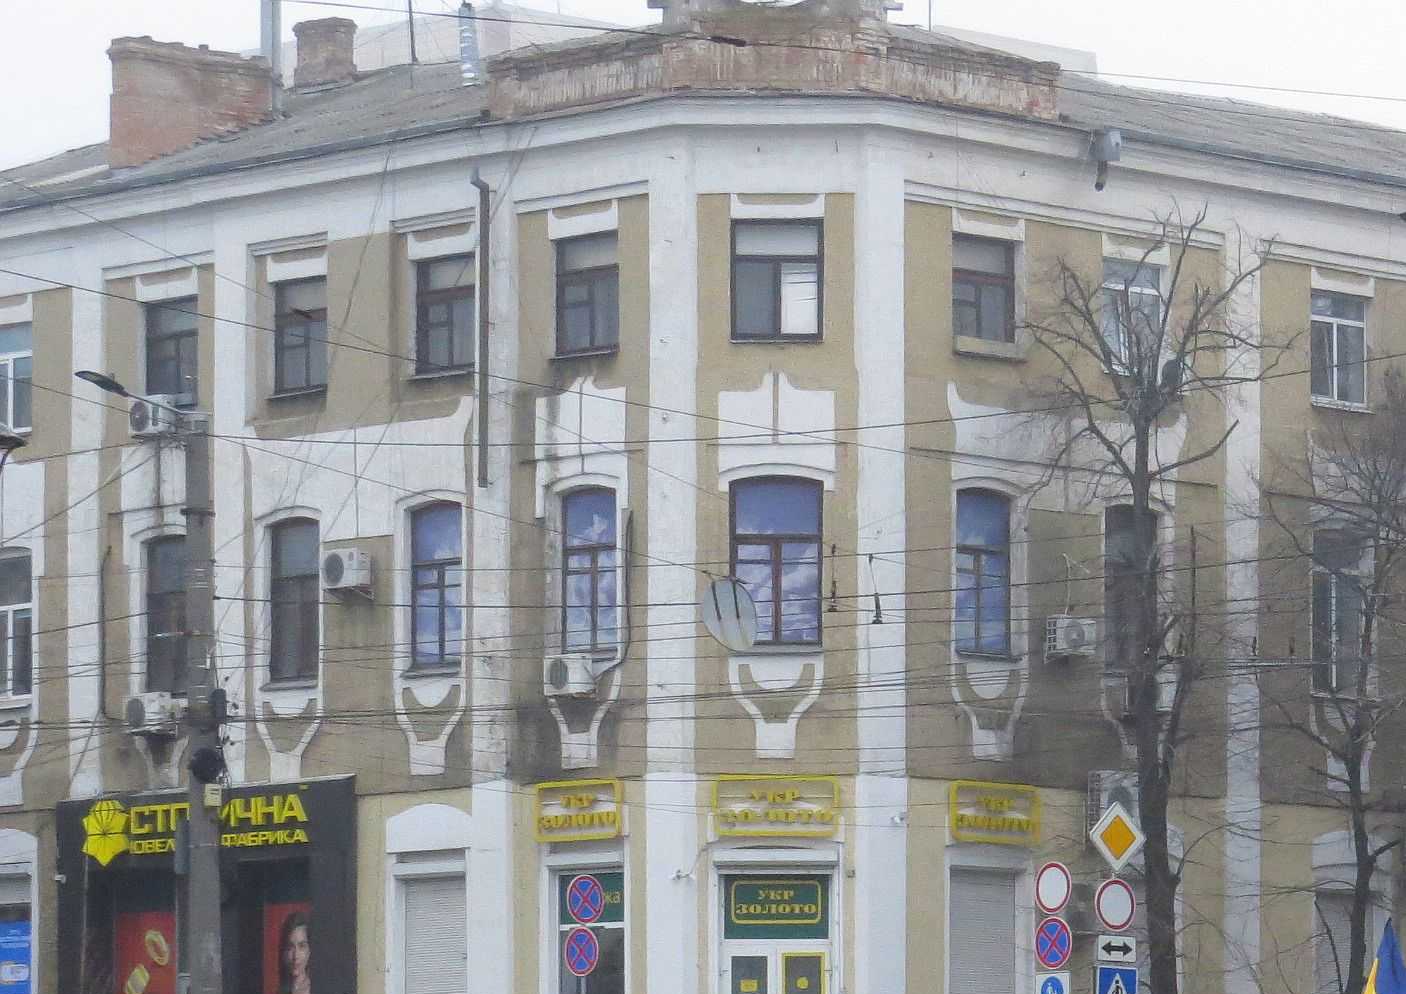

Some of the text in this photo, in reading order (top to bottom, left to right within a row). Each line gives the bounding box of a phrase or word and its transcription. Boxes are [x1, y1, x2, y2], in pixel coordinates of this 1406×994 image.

[220, 828, 308, 848] ФАБРИКА
[758, 888, 794, 900] УКР
[735, 903, 818, 914] ЗОЛОТО
